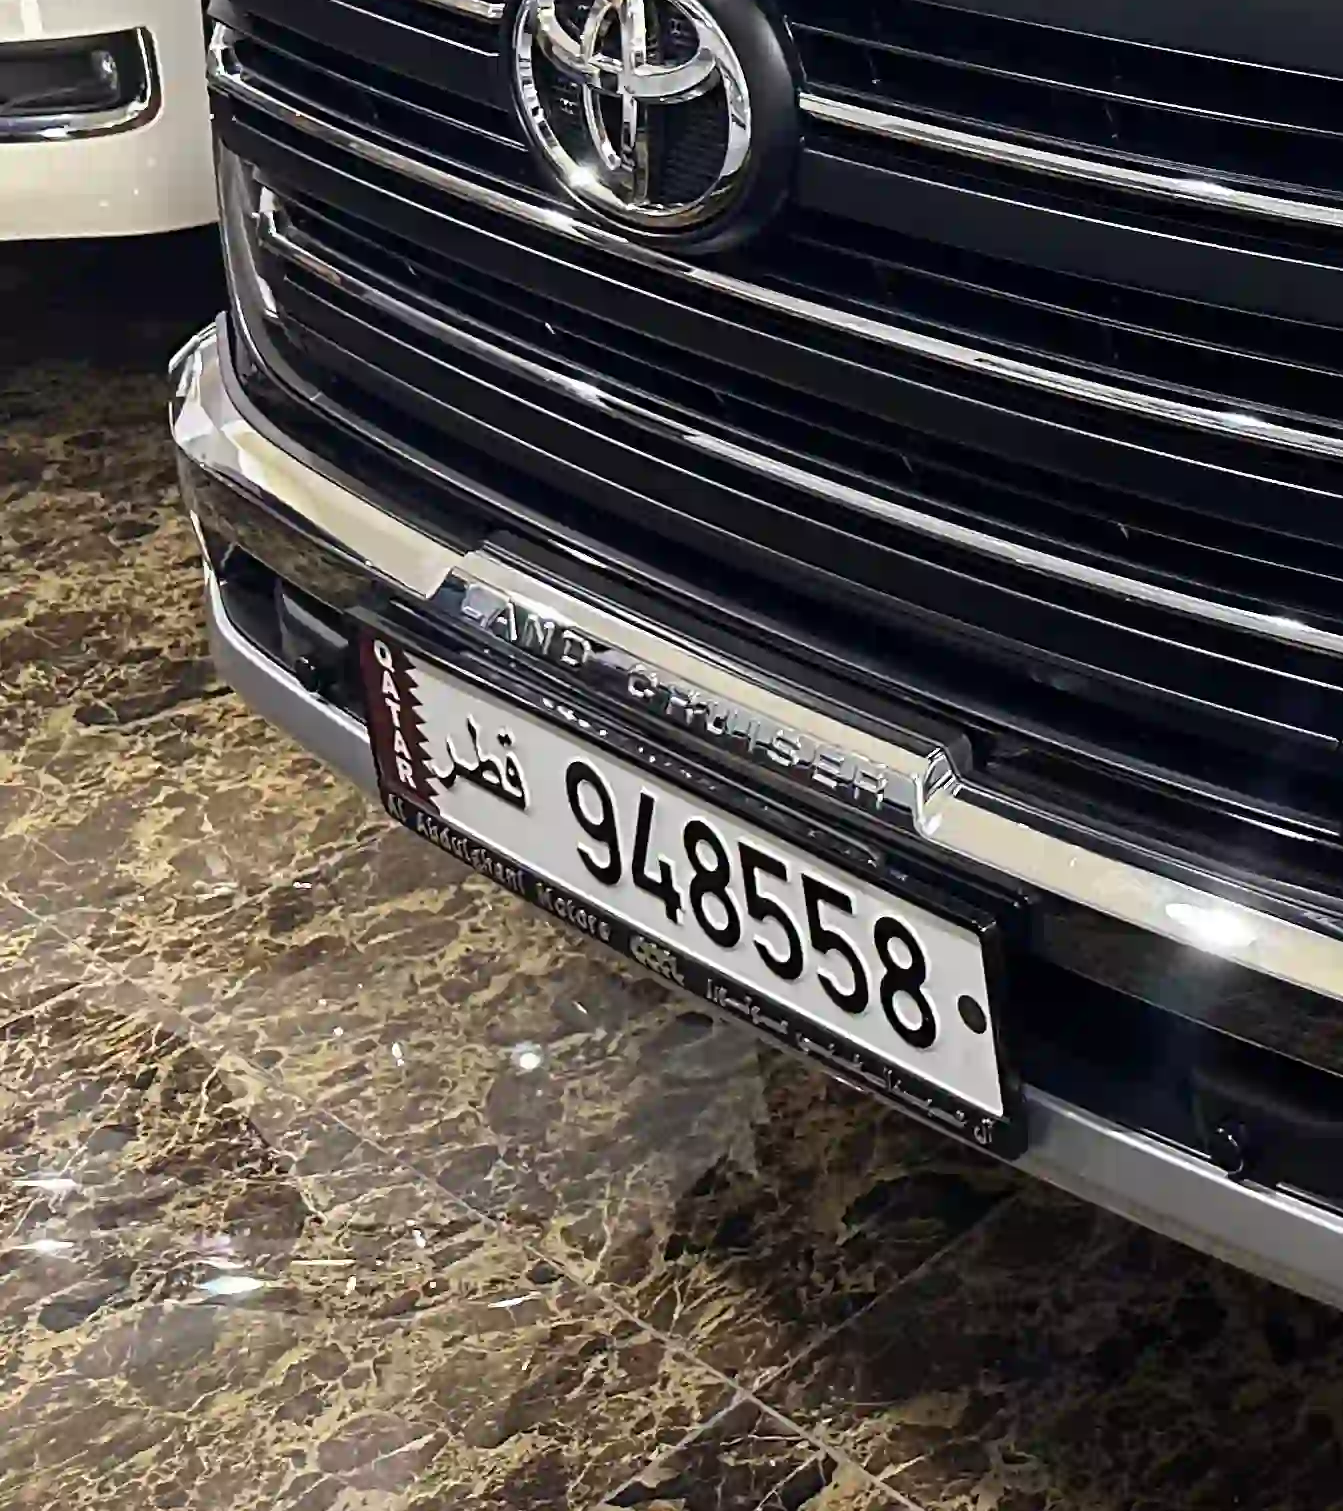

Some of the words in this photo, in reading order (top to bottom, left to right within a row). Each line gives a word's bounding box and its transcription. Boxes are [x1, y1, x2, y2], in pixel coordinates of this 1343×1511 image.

[373, 640, 418, 789] QATAR
[434, 712, 531, 812] قطر
[461, 582, 594, 668] LAND
[627, 662, 889, 812] CRUISER
[536, 881, 611, 943] Motors
[566, 756, 940, 1050] 948558
